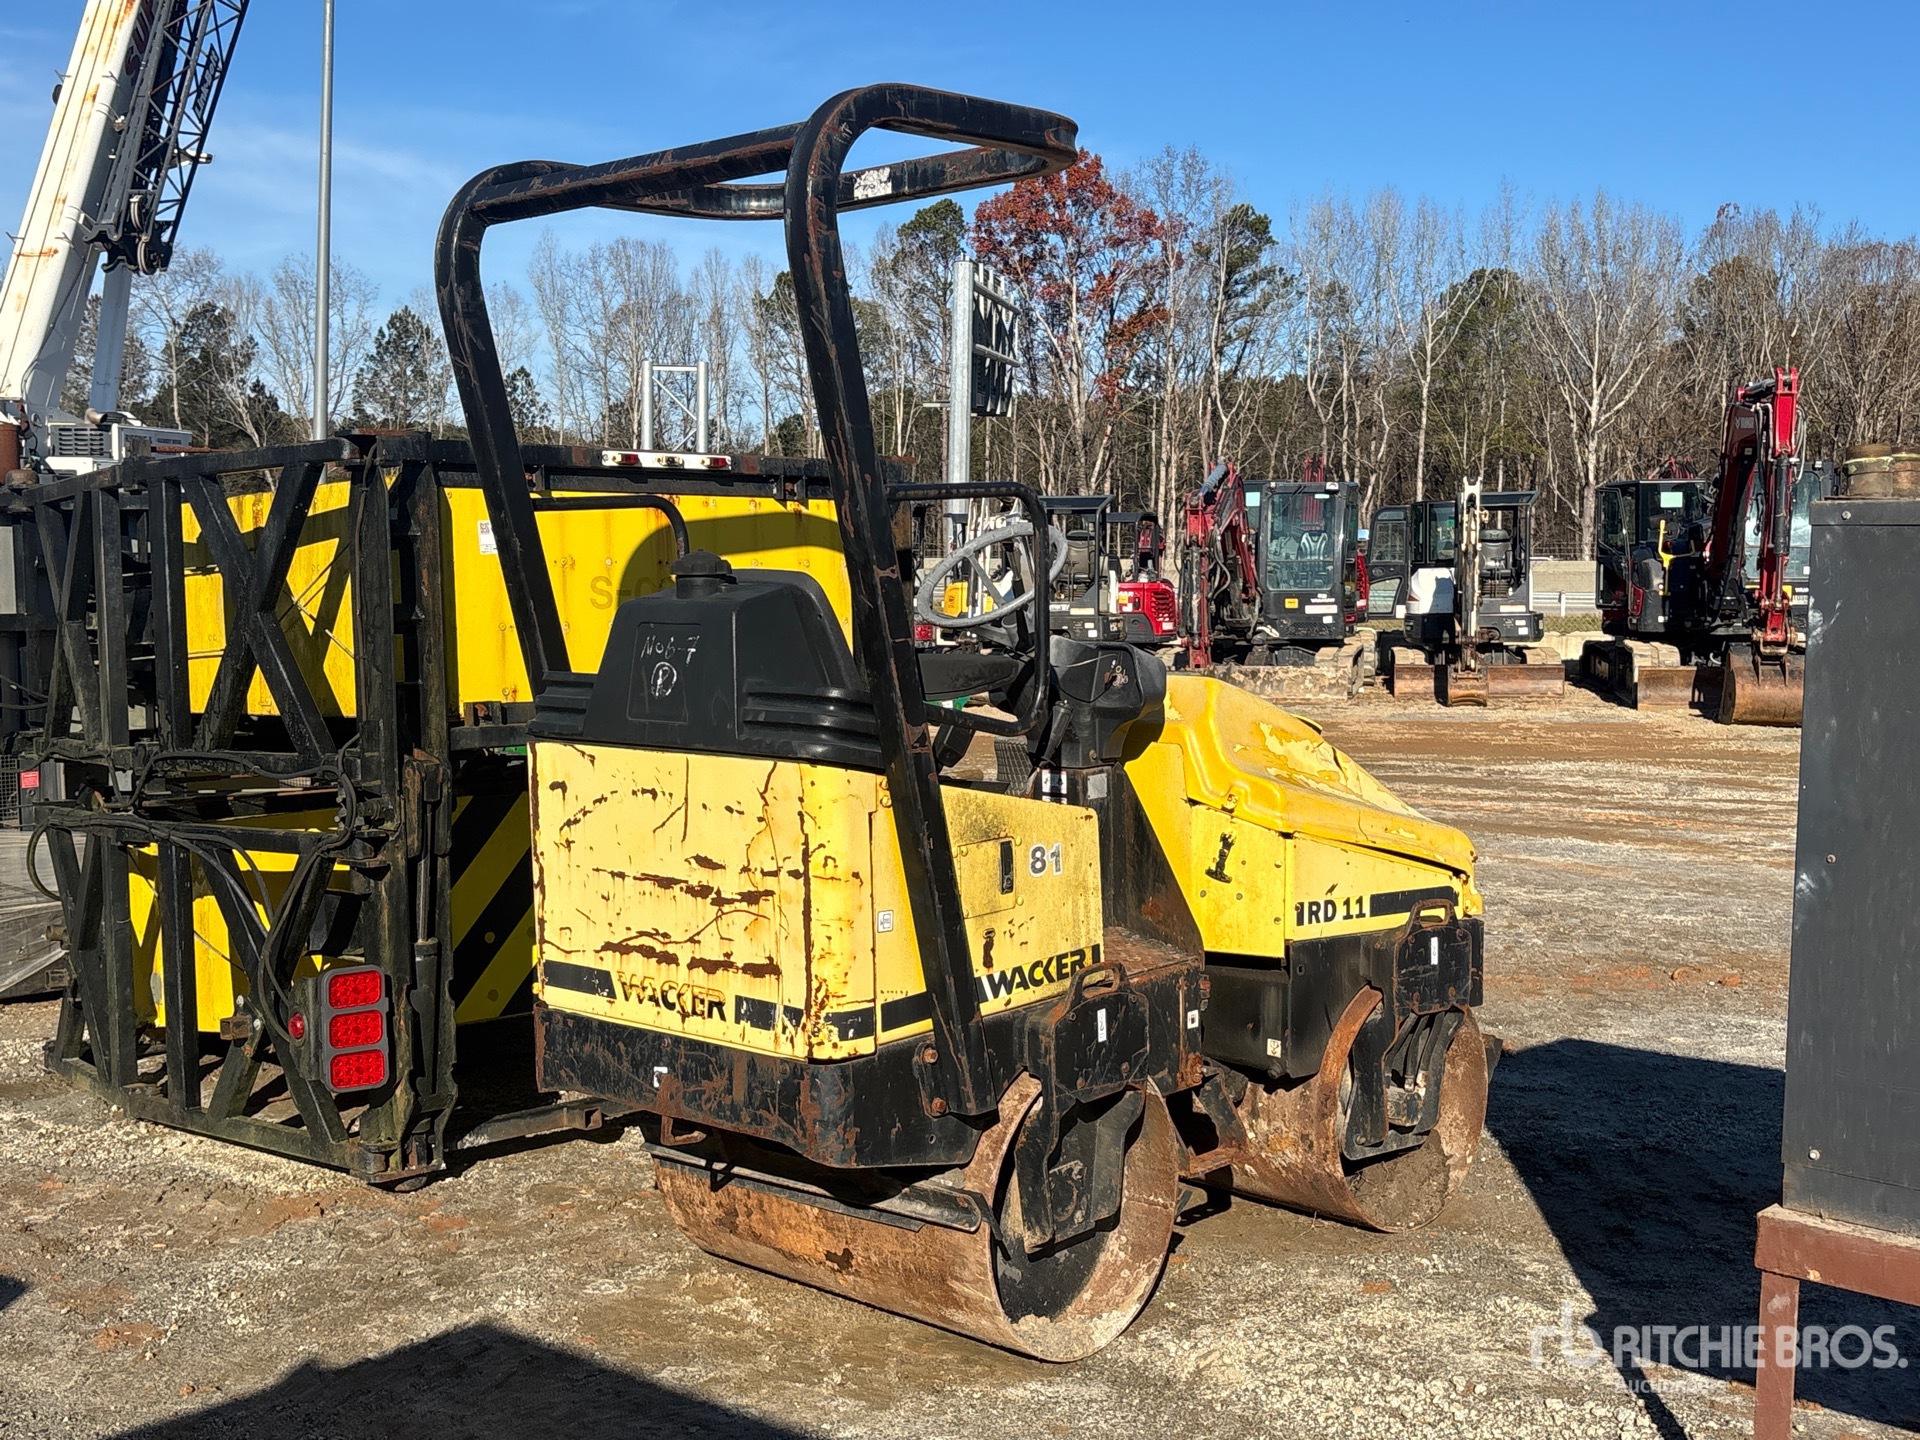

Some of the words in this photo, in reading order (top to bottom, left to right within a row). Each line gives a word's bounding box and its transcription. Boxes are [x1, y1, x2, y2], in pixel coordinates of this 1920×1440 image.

[1029, 843, 1063, 877] 81
[1307, 898, 1338, 924] RD
[1342, 895, 1367, 921] 11
[986, 947, 1087, 1000] WACKER
[617, 970, 728, 1023] WACKER
